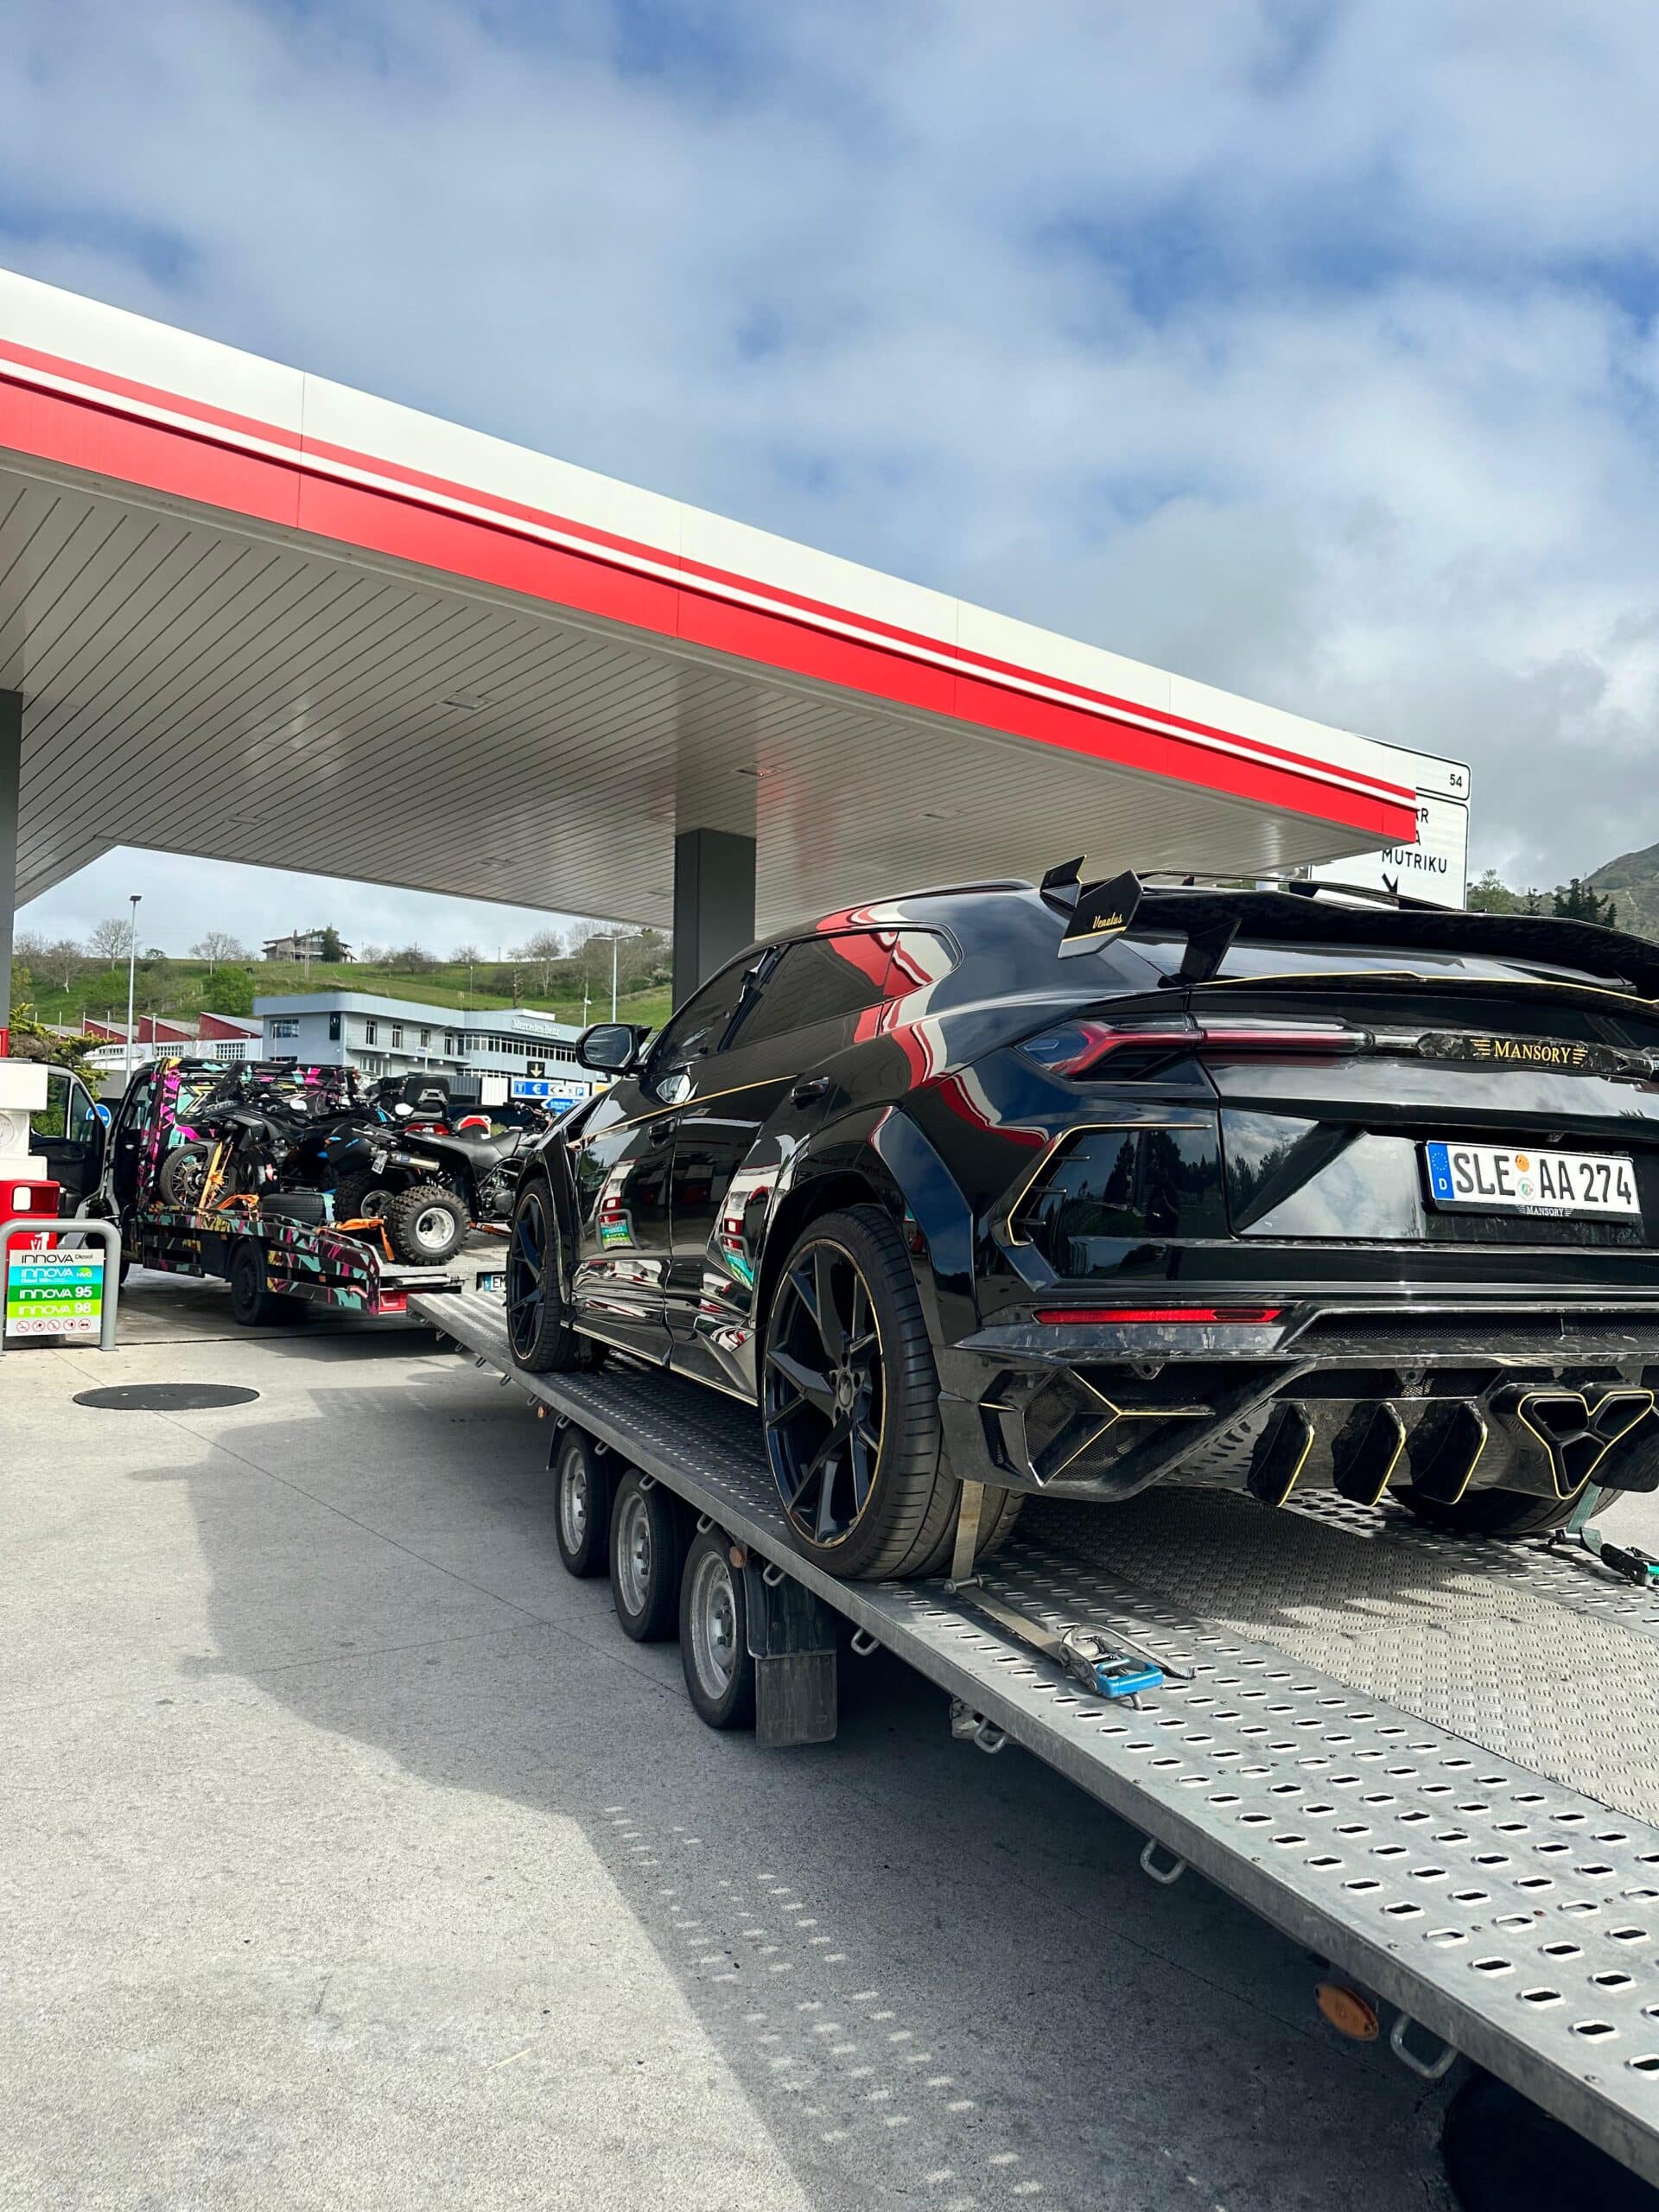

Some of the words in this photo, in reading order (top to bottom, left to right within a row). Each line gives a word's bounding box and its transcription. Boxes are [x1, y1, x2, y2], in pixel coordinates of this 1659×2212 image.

[1450, 774, 1462, 787] 54
[1382, 849, 1447, 874] MUTRIKU
[1494, 1040, 1571, 1064] MANSORY
[532, 1084, 542, 1094] €
[1439, 1178, 1447, 1191] D
[1453, 1153, 1516, 1196] SLE
[1539, 1159, 1575, 1200] AA
[1580, 1163, 1631, 1205] 274
[1526, 1205, 1564, 1217] MANSORY
[75, 1286, 92, 1298] 95
[74, 1302, 92, 1313] 98
